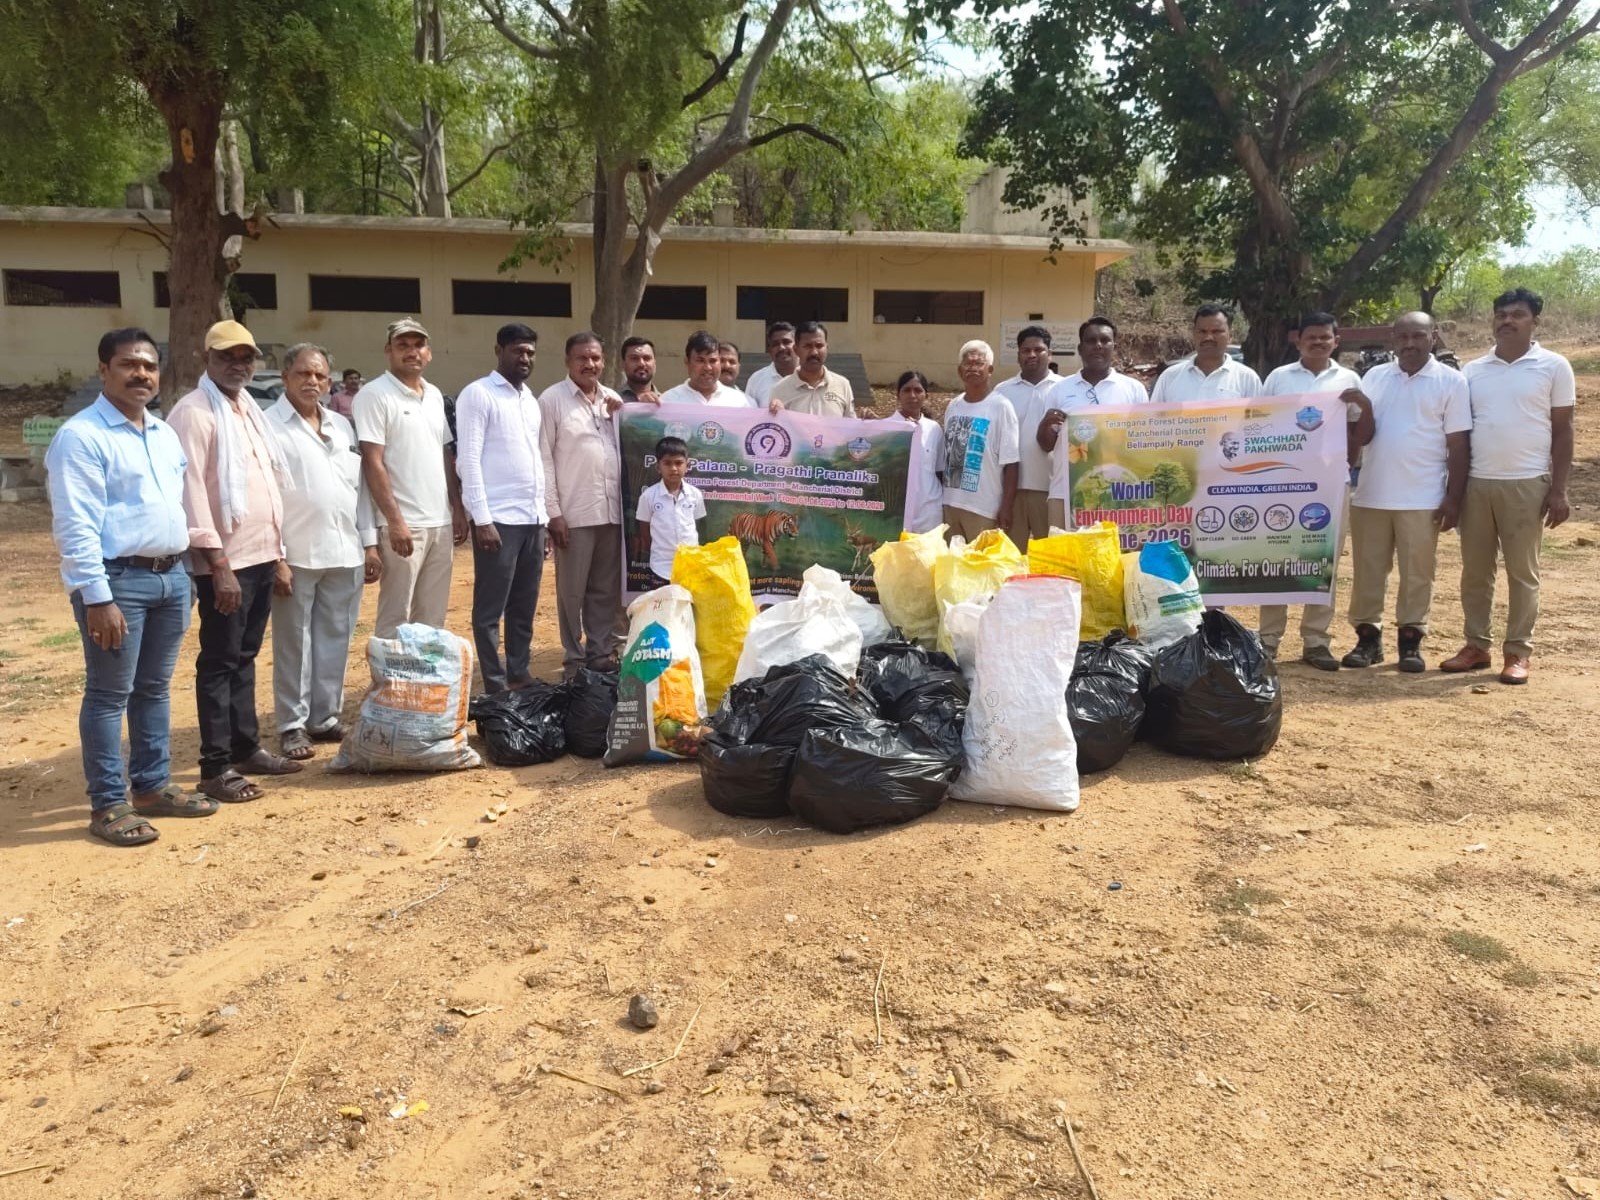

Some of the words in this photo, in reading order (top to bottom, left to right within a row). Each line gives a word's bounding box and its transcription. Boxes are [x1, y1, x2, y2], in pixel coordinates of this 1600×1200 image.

[1105, 419, 1146, 429] Telangana
[1149, 417, 1176, 426] Forest
[1178, 415, 1227, 426] Department
[1127, 428, 1173, 438] Mancherial
[1175, 427, 1206, 436] District
[1244, 434, 1307, 445] SWACHHATA
[1127, 440, 1174, 449] Bellampally
[1177, 439, 1204, 448] Range
[1244, 442, 1303, 454] PAKHWADA
[688, 458, 737, 473] Palana
[754, 462, 812, 479] Pragathi
[815, 467, 879, 483] Pranalika
[713, 478, 739, 487] Forest
[741, 480, 785, 489] Department
[792, 483, 833, 494] Mancherial
[834, 486, 863, 495] District
[1111, 481, 1154, 500] World
[777, 493, 798, 504] From
[837, 499, 846, 508] to
[1075, 506, 1164, 526] Environment
[1166, 504, 1193, 524] Day
[1120, 532, 1137, 549] ne
[1196, 560, 1238, 578] Climate.
[1242, 559, 1259, 577] For
[1262, 559, 1281, 577] Our
